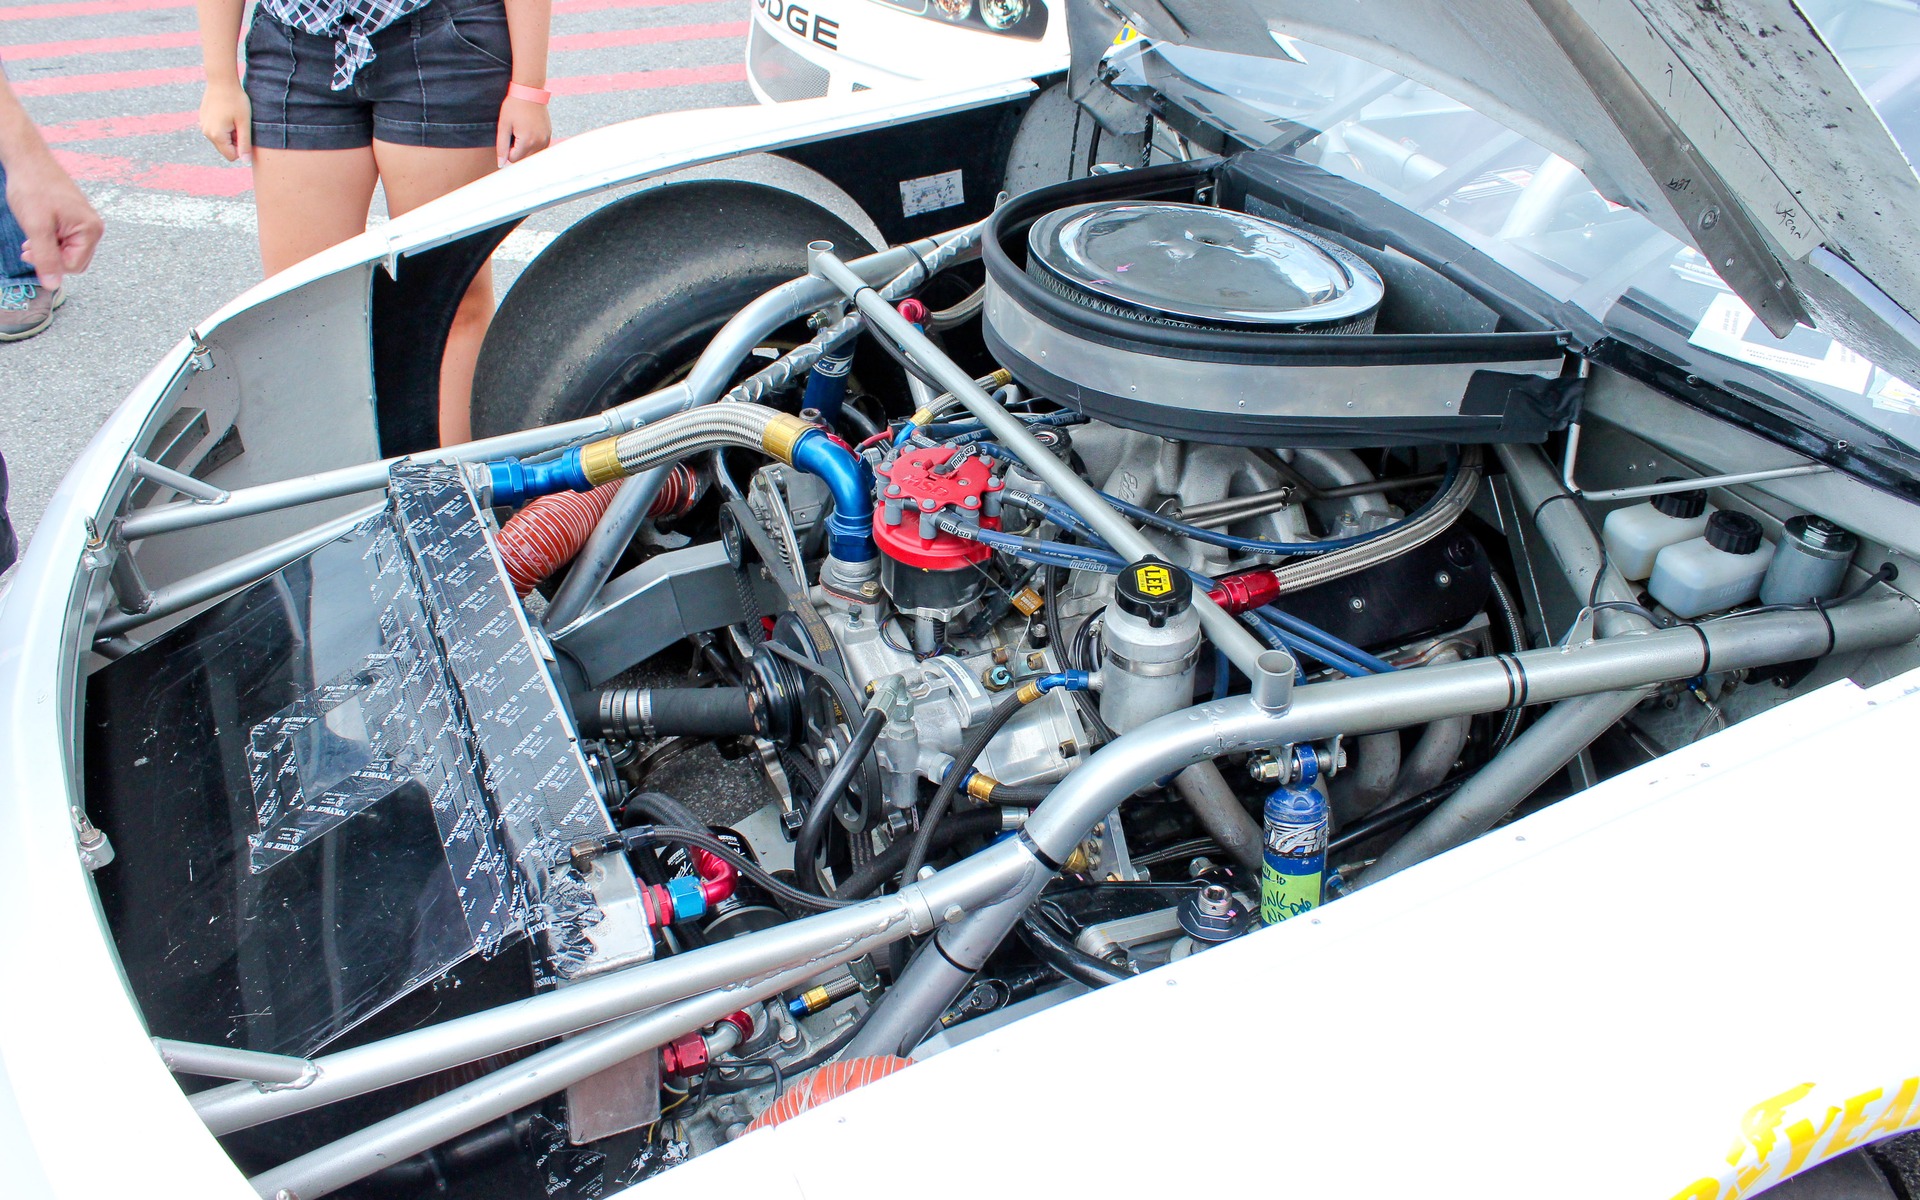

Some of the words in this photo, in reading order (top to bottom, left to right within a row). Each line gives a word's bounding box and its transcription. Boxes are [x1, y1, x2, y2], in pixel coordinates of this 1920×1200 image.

[1070, 560, 1107, 572] MOROSO
[1144, 569, 1164, 592] LEE
[533, 763, 561, 791] POLYKEN
[560, 796, 588, 826] POLYKEN
